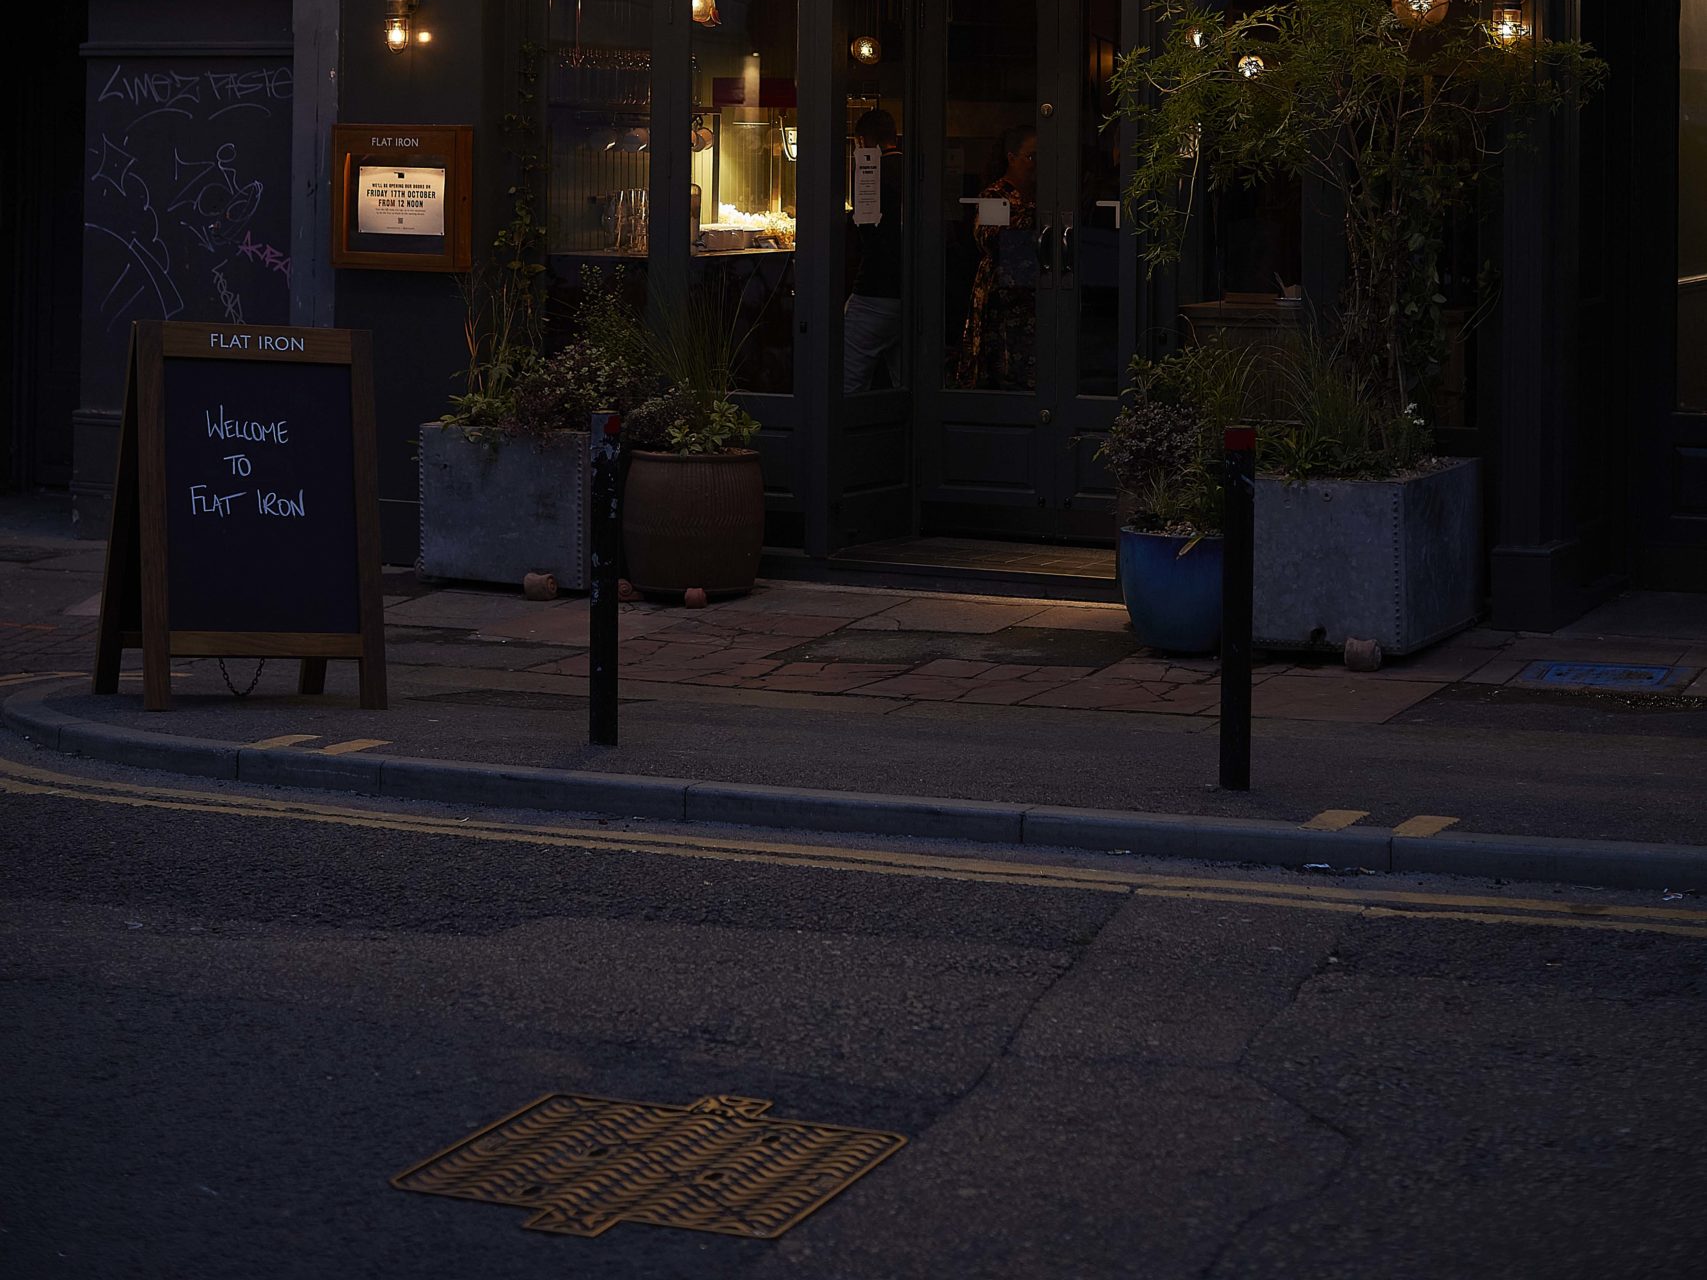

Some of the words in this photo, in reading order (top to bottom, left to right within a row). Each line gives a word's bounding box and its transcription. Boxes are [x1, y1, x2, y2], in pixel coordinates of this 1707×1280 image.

[371, 137, 393, 146] FLAT
[395, 137, 419, 147] IRON
[366, 189, 388, 197] FRIDAY
[390, 190, 406, 198] 17TH
[407, 190, 436, 199] OCTOBER
[378, 199, 395, 207] FROM
[398, 200, 405, 208] 12
[406, 200, 424, 208] NOON
[210, 333, 251, 349] FLAT
[258, 335, 305, 352] IRON
[205, 404, 289, 444] WELCOME
[223, 453, 252, 477] TO
[189, 484, 248, 518] FLAT
[256, 488, 305, 517] IRON
